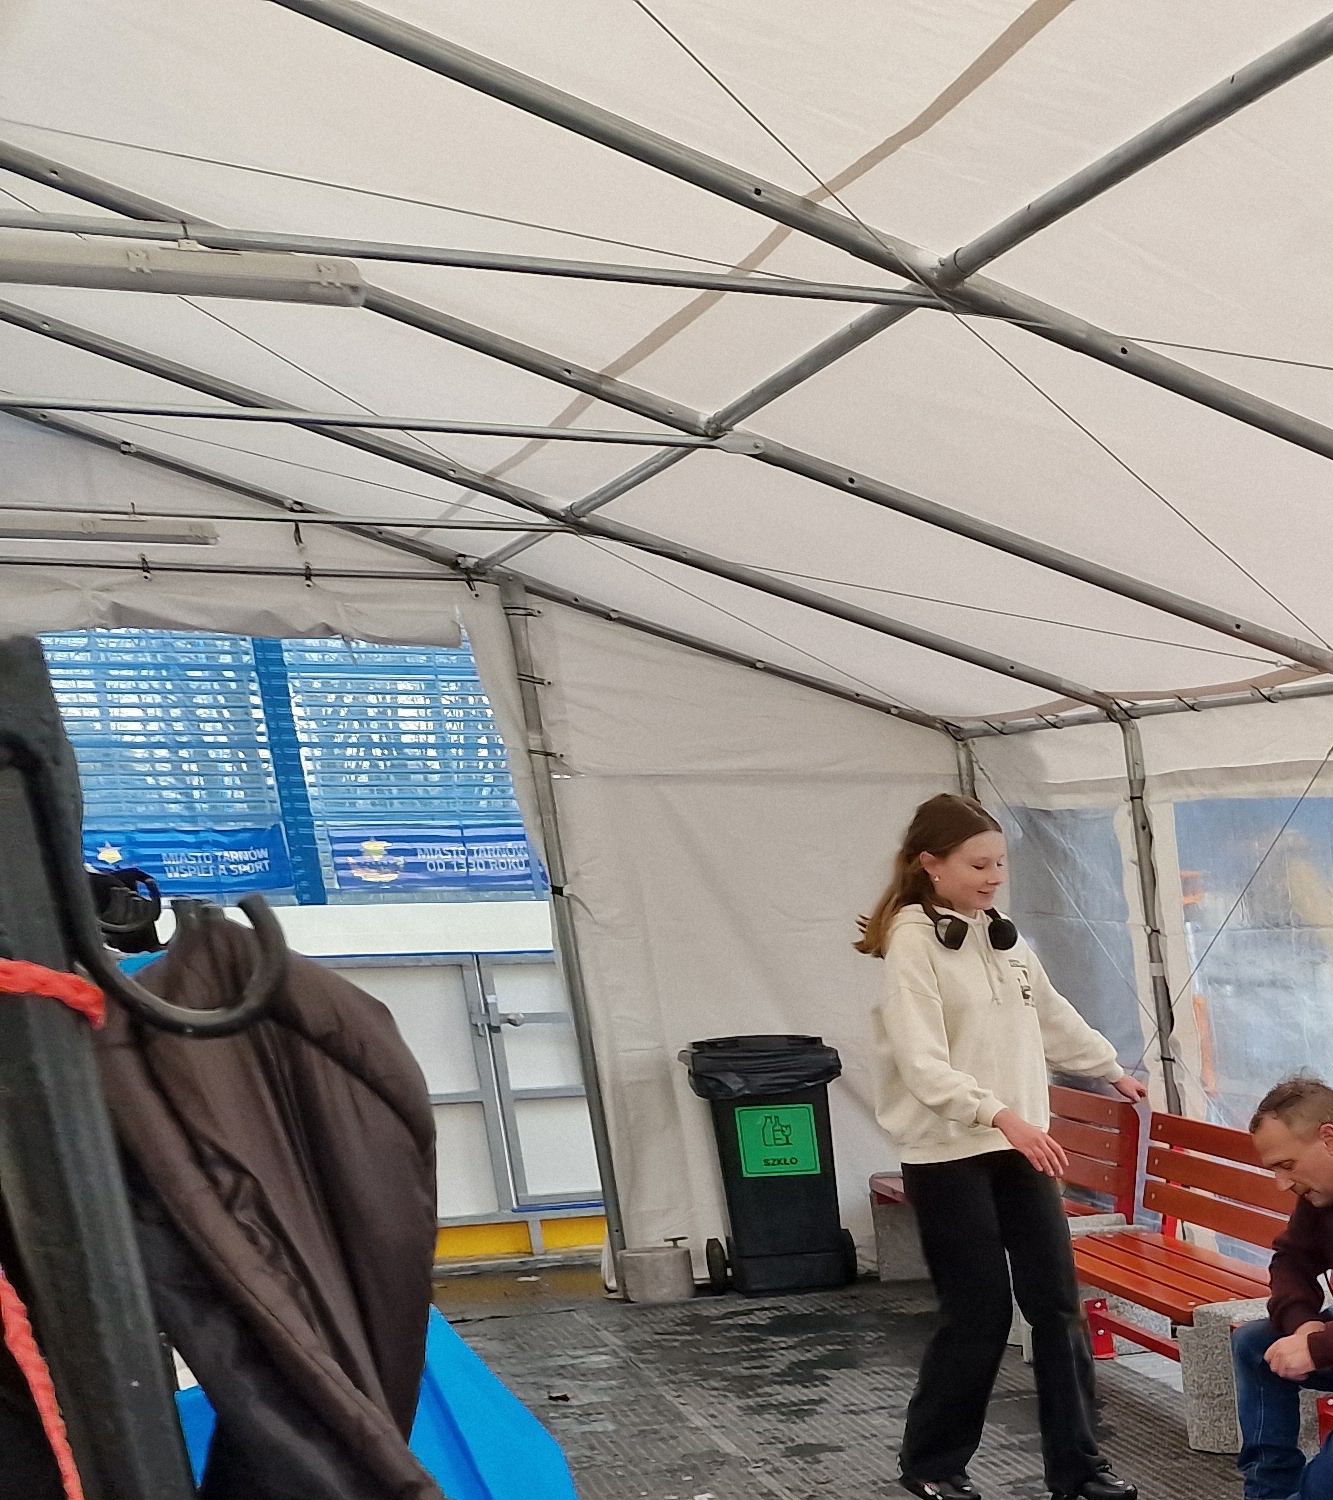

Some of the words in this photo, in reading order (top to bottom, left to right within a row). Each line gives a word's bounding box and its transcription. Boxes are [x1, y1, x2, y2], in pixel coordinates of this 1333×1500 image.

[162, 852, 212, 864] MIASTO
[214, 846, 269, 862] TARNÓW
[417, 847, 467, 859] MIASTO
[229, 860, 270, 876] SPORT
[427, 860, 446, 871] OD
[452, 860, 486, 872] 1330
[489, 859, 526, 871] ROKU
